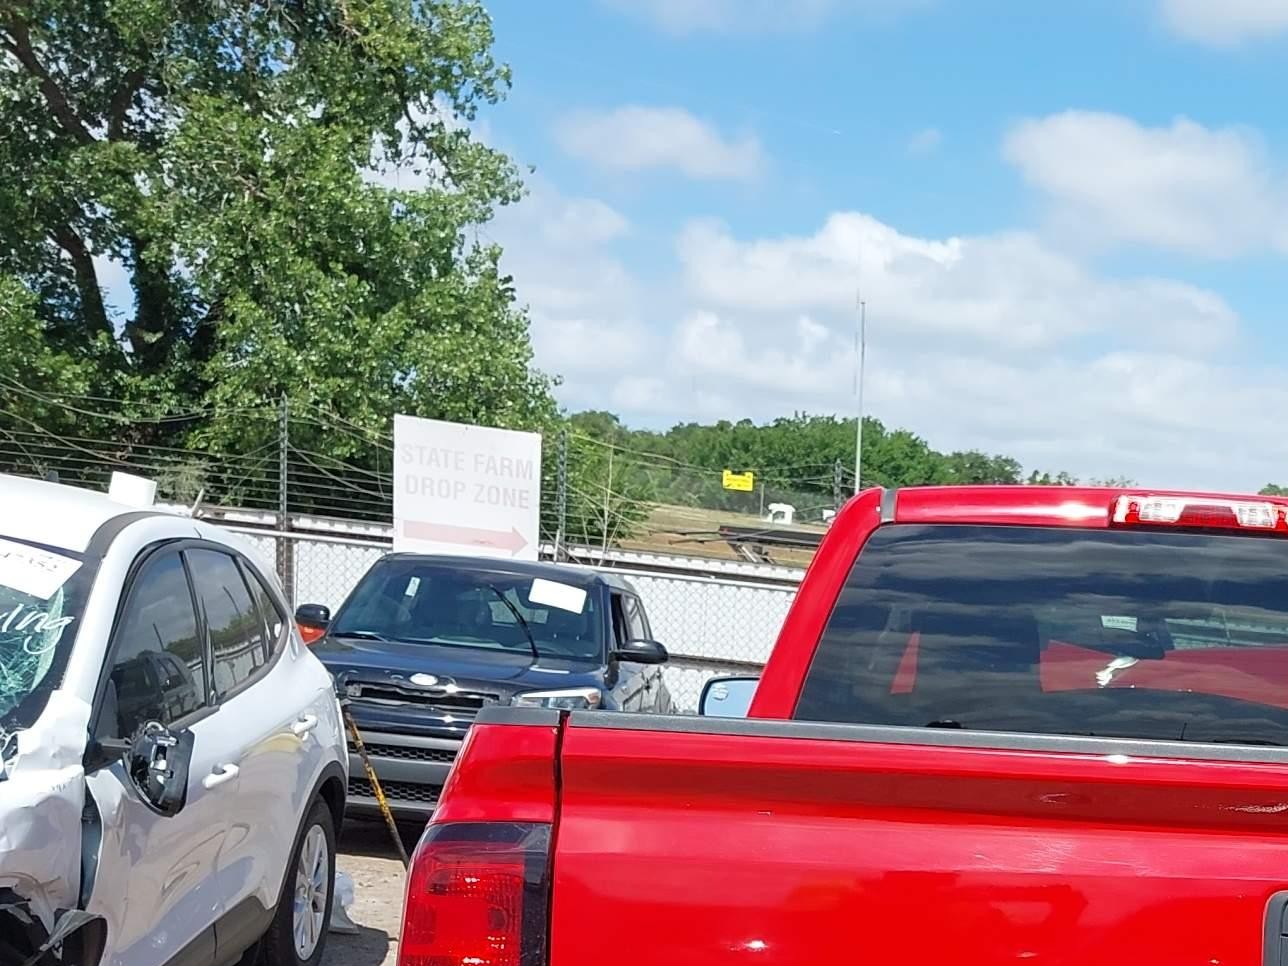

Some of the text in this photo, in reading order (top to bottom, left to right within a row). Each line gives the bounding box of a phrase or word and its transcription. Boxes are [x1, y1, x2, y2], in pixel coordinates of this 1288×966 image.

[401, 443, 534, 481] STATE FARM
[405, 475, 530, 509] DROP ZONE
